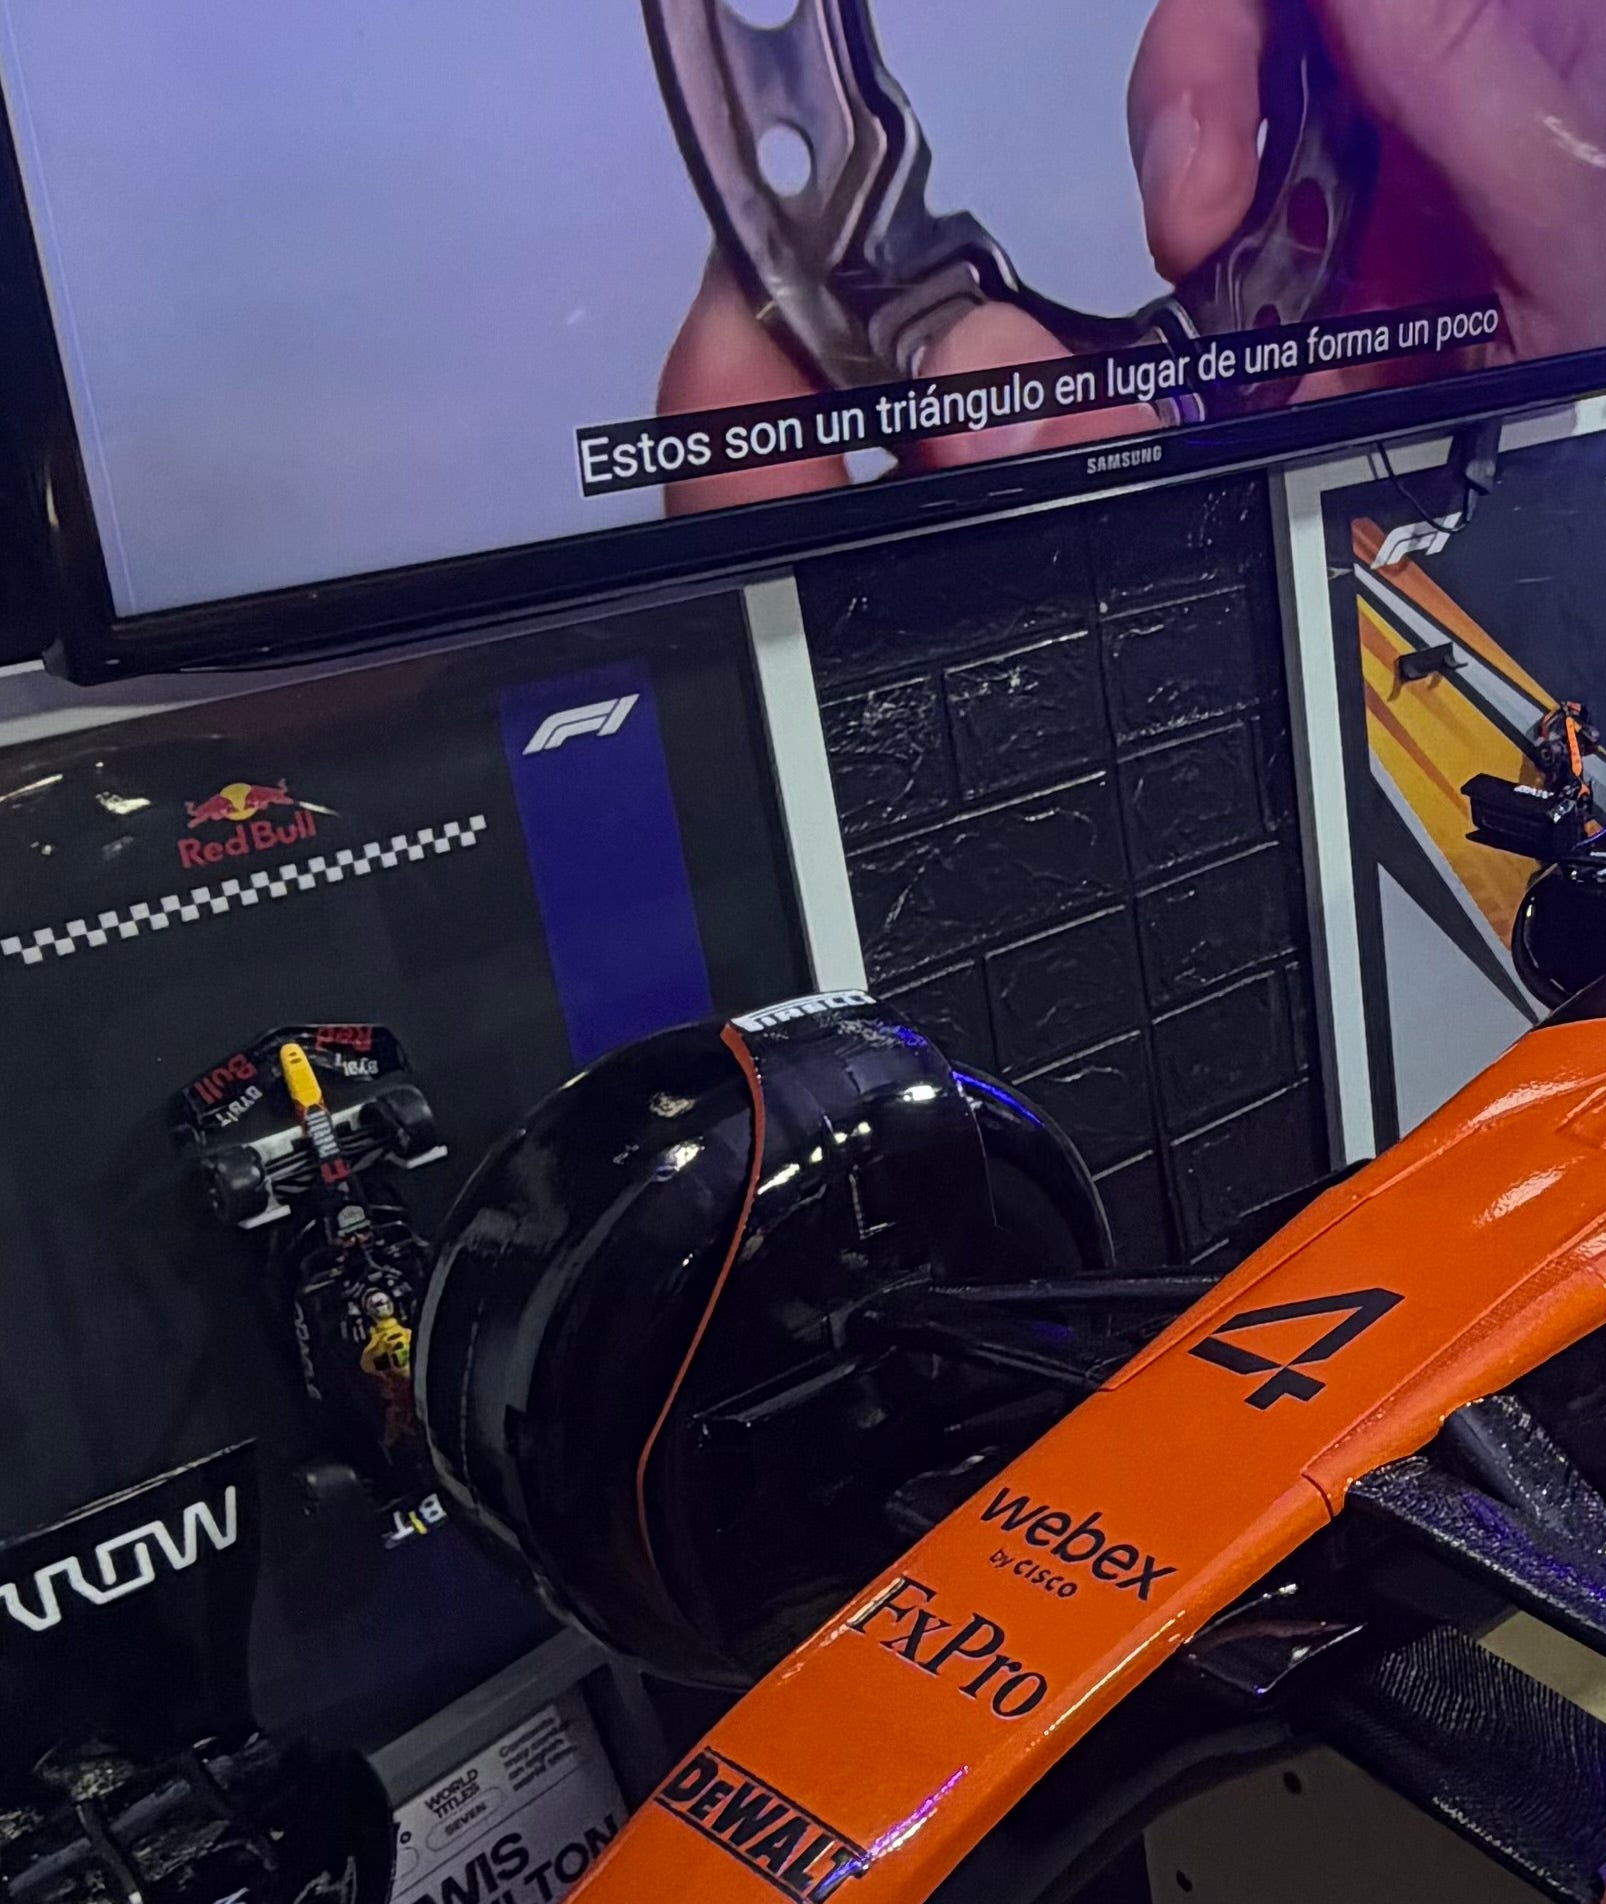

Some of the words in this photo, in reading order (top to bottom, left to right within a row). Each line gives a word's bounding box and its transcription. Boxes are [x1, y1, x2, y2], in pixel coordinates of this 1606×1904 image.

[580, 431, 712, 485] Estos
[724, 421, 803, 459] son
[816, 408, 866, 445] un
[875, 372, 1045, 435] triángulo
[1054, 372, 1097, 405] en
[1107, 356, 1190, 402] lugar
[1198, 342, 1236, 382] de
[1244, 339, 1298, 374] una
[1307, 326, 1390, 364] forma
[1398, 319, 1430, 349] un
[1436, 307, 1499, 351] poco
[1086, 444, 1163, 475] SAMSUNG
[177, 825, 248, 869] Red
[250, 813, 317, 854] Bull
[1188, 1287, 1405, 1411] 4
[390, 1492, 448, 1542] BIT
[979, 1486, 1178, 1602] webex
[989, 1548, 1014, 1569] by
[848, 1574, 1049, 1721] FxPro
[423, 1767, 479, 1812] WORLD
[433, 1781, 481, 1820] TITLES
[444, 1801, 488, 1837] SEVEN
